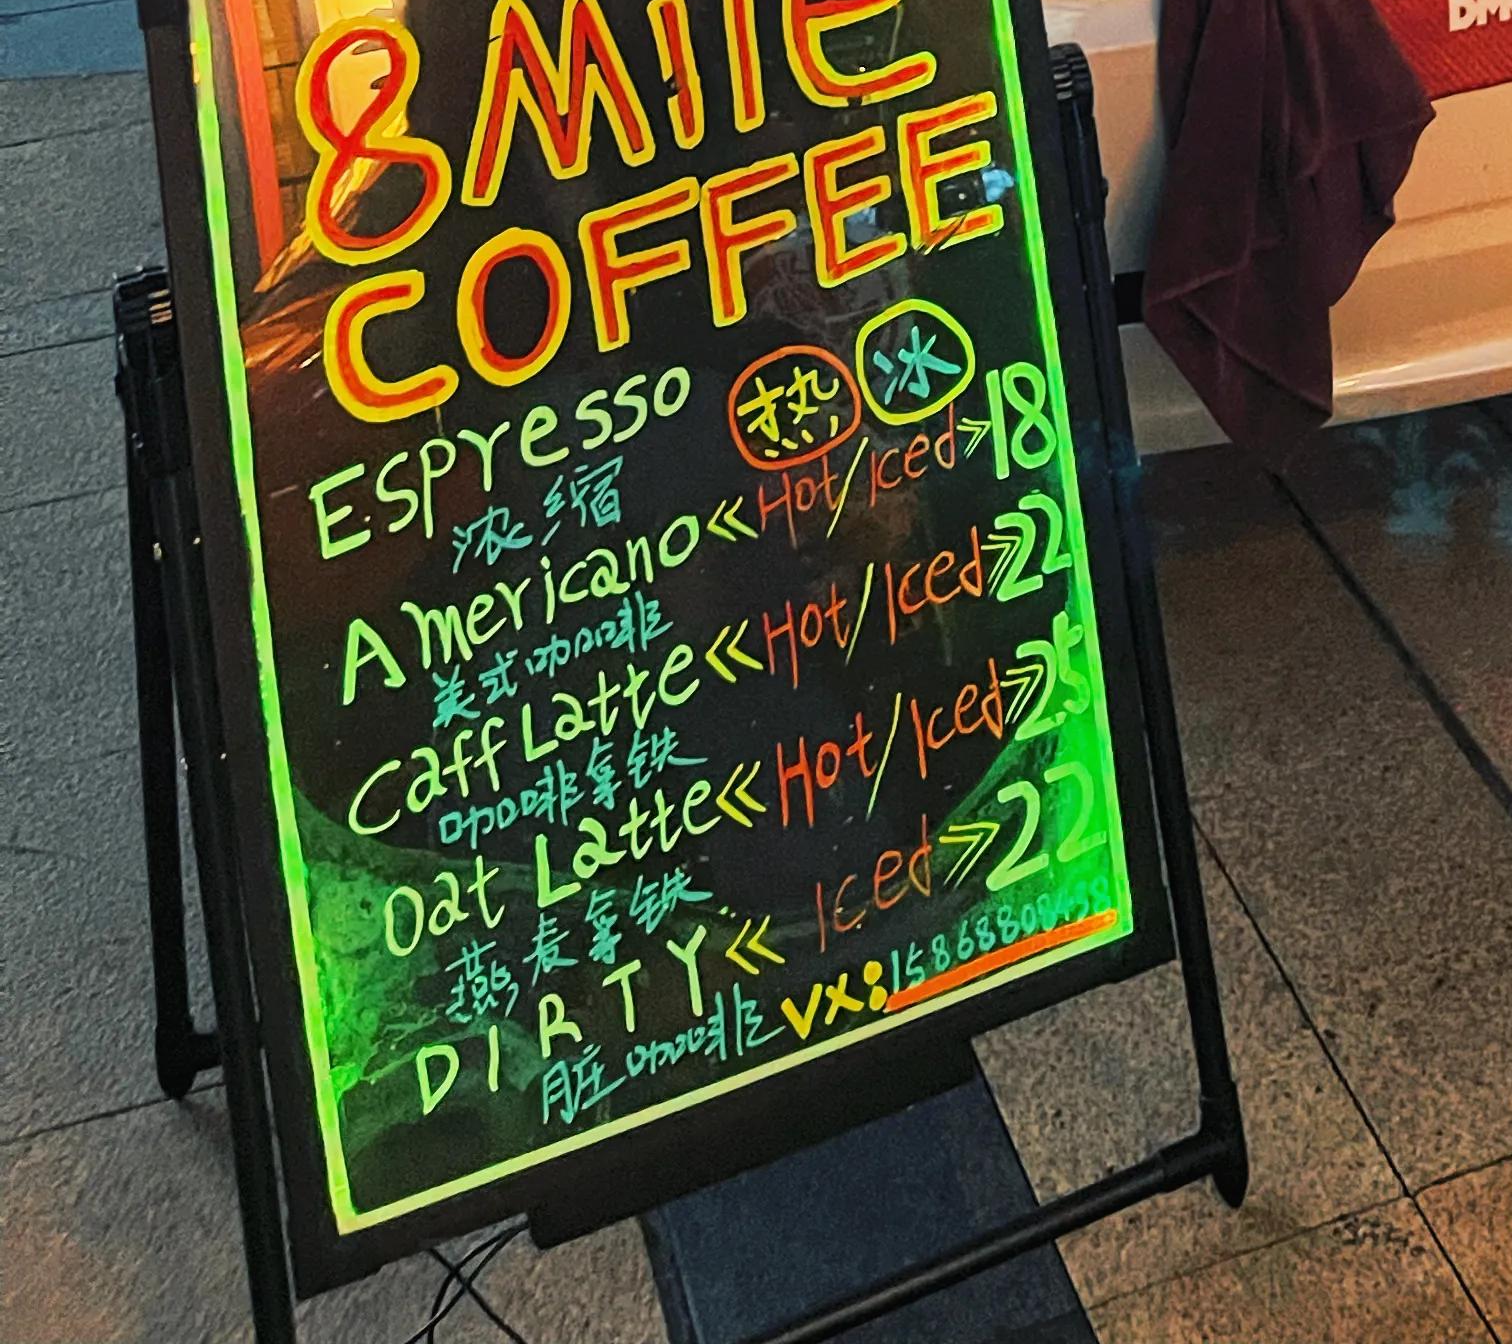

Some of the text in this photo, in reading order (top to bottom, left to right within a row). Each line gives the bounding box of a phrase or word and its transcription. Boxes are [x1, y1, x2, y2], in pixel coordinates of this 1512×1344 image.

[296, 15, 452, 266] 8
[323, 90, 1004, 424] COFFEE
[308, 365, 692, 560] Espresso
[737, 324, 963, 459] 热 冰
[340, 513, 702, 707] Americano
[985, 361, 1058, 481] 18
[451, 455, 625, 575] 浓缩
[994, 488, 1074, 603] 22
[431, 589, 675, 729] 美式咖啡
[383, 854, 506, 958] Oat
[533, 779, 723, 909] Latte
[1014, 610, 1092, 742] 25
[438, 724, 709, 850] 咖啡拿铁
[985, 761, 1107, 892] 22
[444, 866, 714, 1024] 燕麦拿铁
[541, 982, 787, 1126] 脏咖啡
